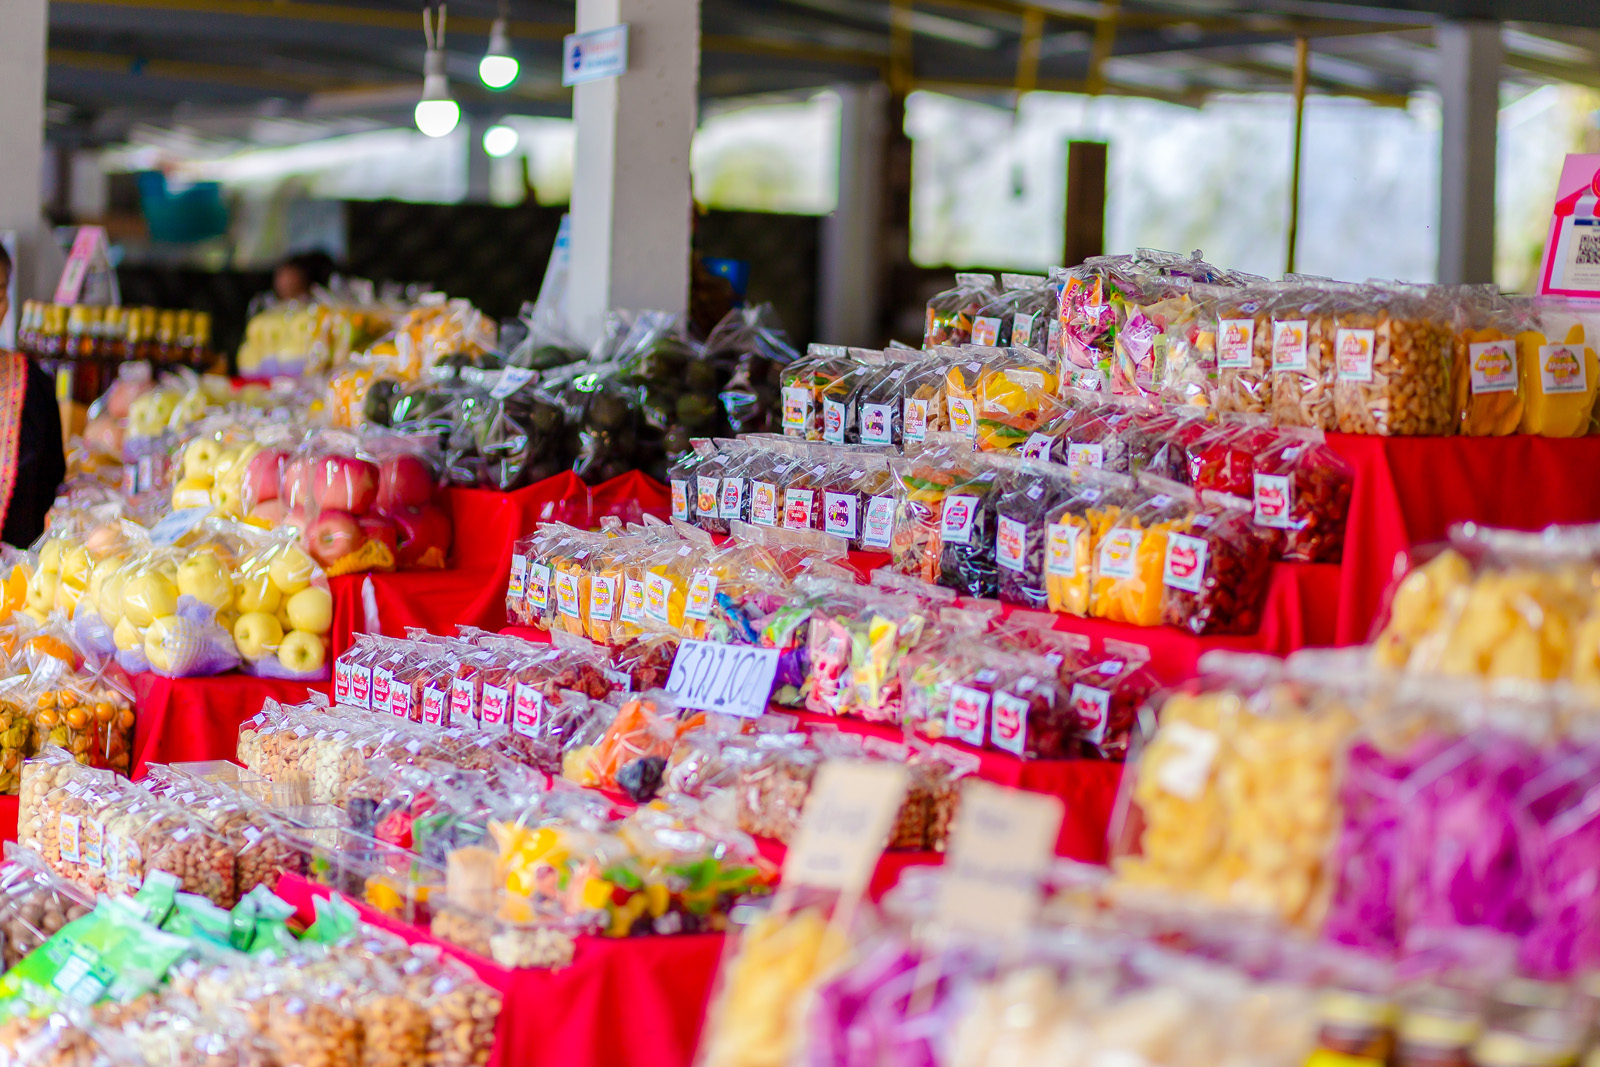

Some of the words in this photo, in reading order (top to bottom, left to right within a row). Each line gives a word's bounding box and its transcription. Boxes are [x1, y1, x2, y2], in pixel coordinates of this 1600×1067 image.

[1548, 360, 1578, 373] Mango
[952, 410, 970, 421] Mango
[593, 590, 610, 601] Mango
[648, 586, 664, 603] Mango
